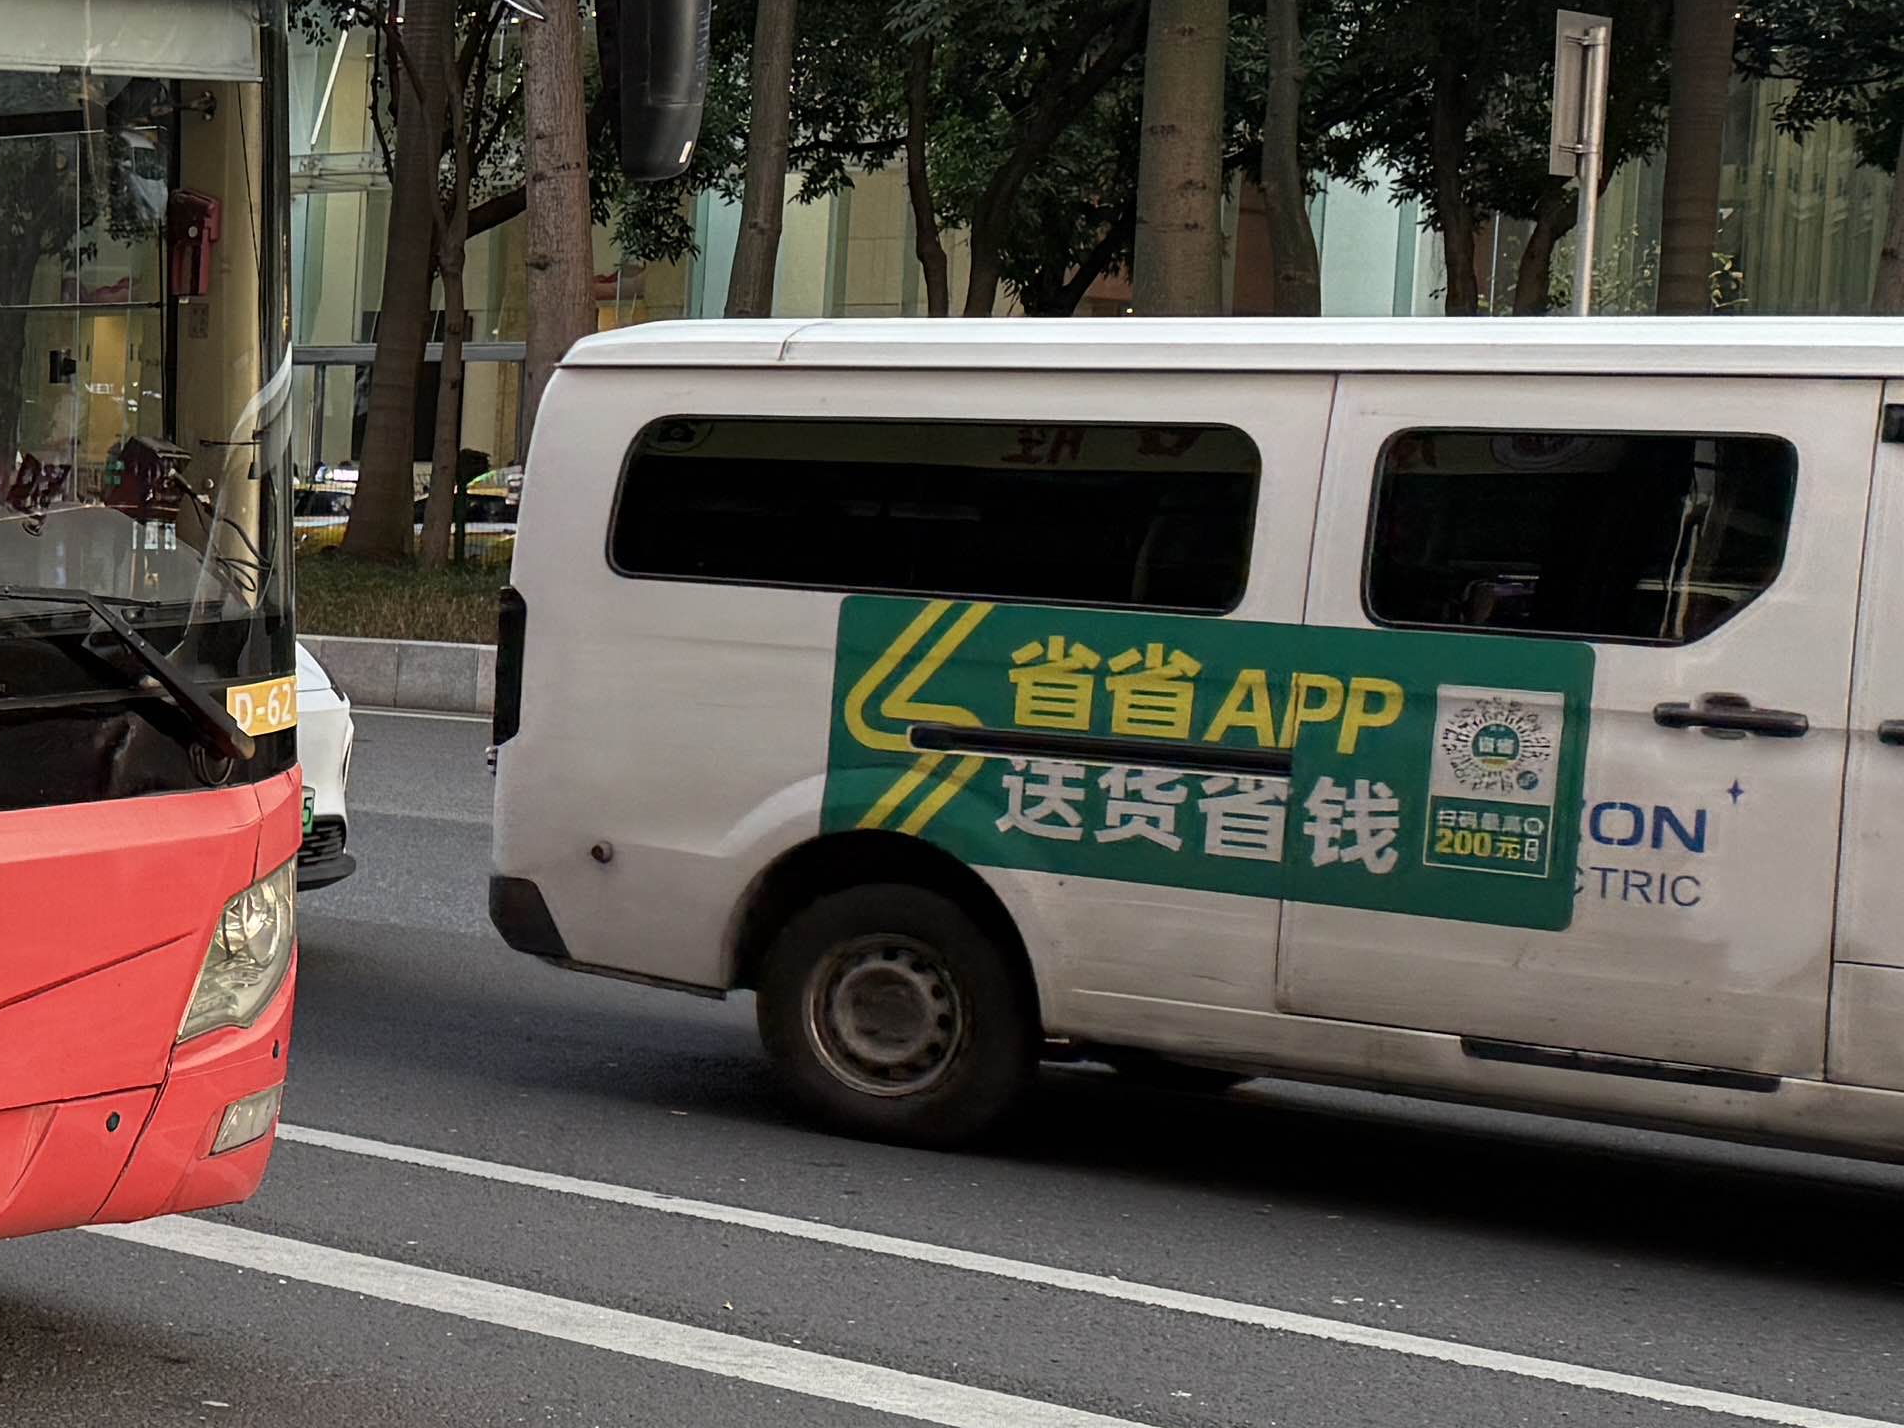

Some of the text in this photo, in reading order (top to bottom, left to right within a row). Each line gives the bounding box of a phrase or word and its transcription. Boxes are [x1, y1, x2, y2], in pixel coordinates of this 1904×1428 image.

[235, 682, 297, 730] D-62
[995, 757, 1401, 874] 送货省钱
[1589, 801, 1707, 853] ON
[1575, 865, 1701, 907] TRIC
